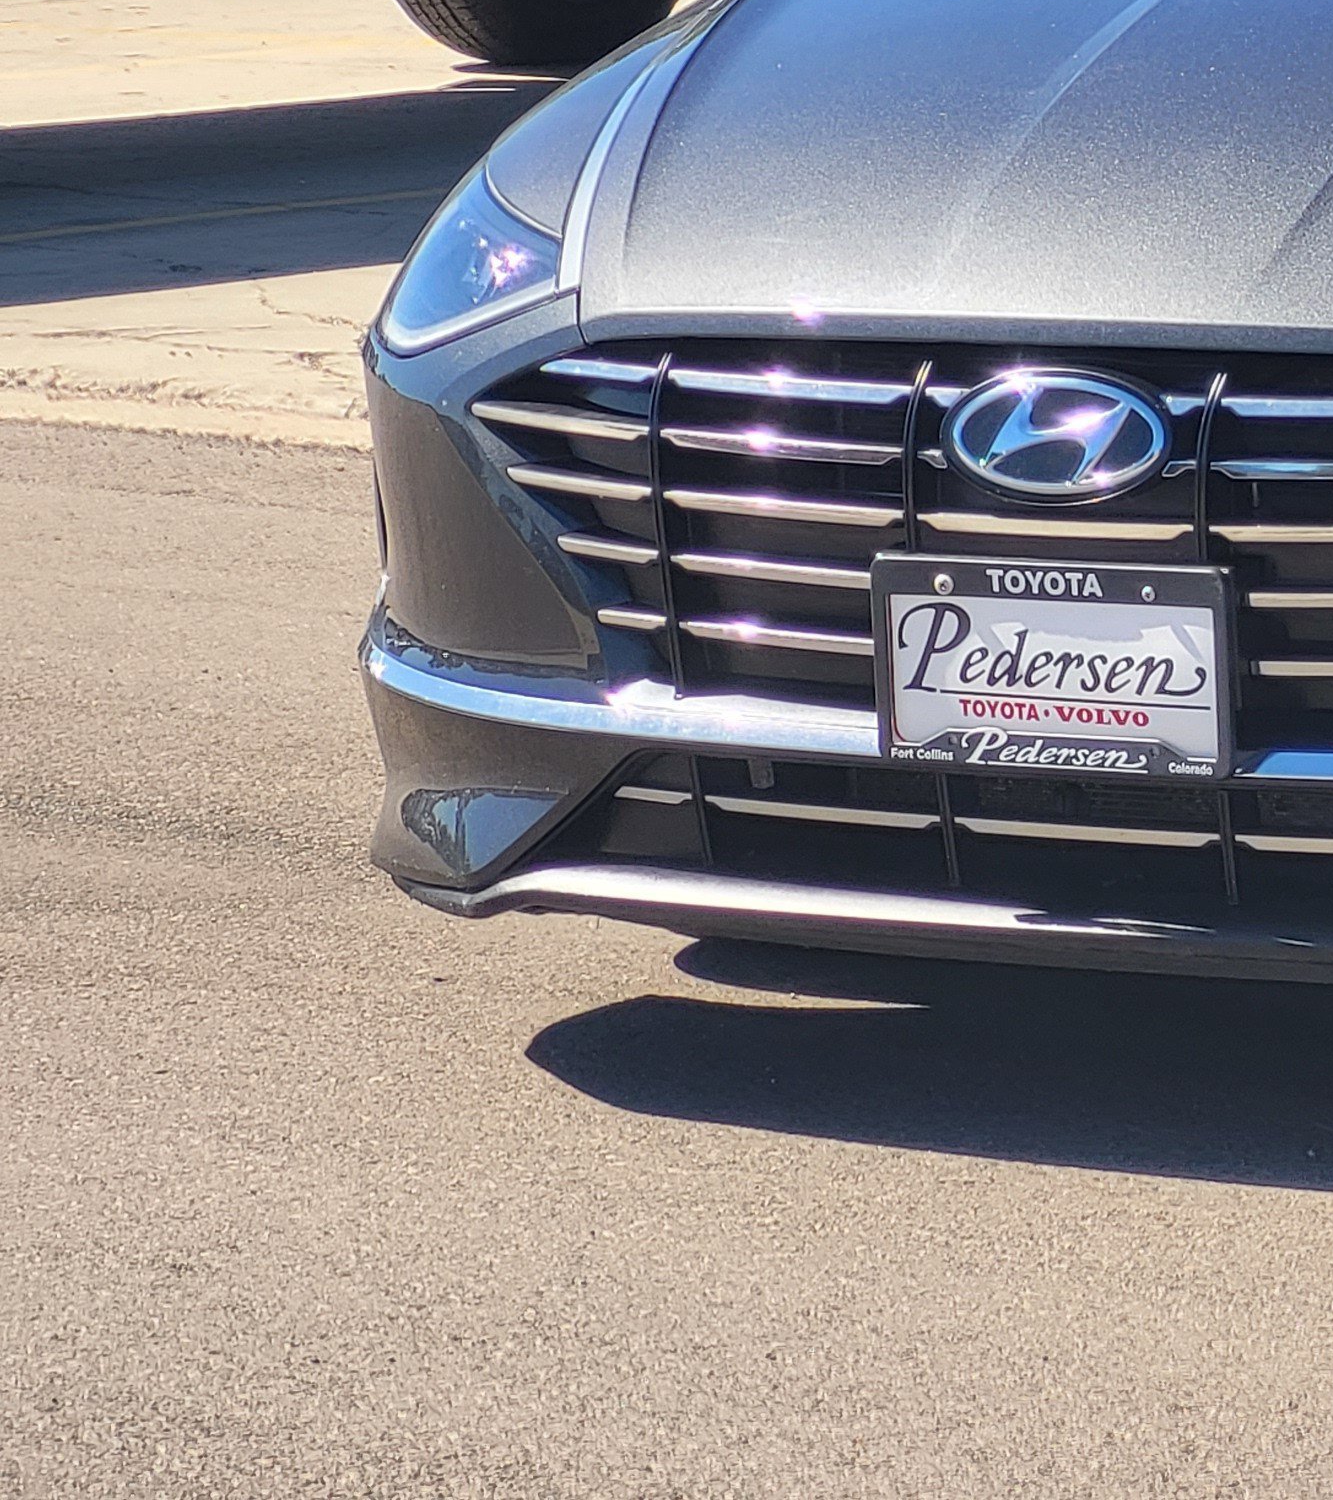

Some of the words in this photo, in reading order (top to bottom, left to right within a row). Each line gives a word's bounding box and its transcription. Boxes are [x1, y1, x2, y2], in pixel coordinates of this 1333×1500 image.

[985, 568, 1103, 598] TOYOTA
[898, 602, 1207, 697] Pedersen
[959, 698, 1041, 722] TOYOTA
[1053, 705, 1150, 727] VOLVO
[890, 746, 915, 759] Fort
[916, 747, 954, 762] Collins
[961, 727, 1148, 770] Pedersen
[1168, 761, 1214, 777] Colorado
